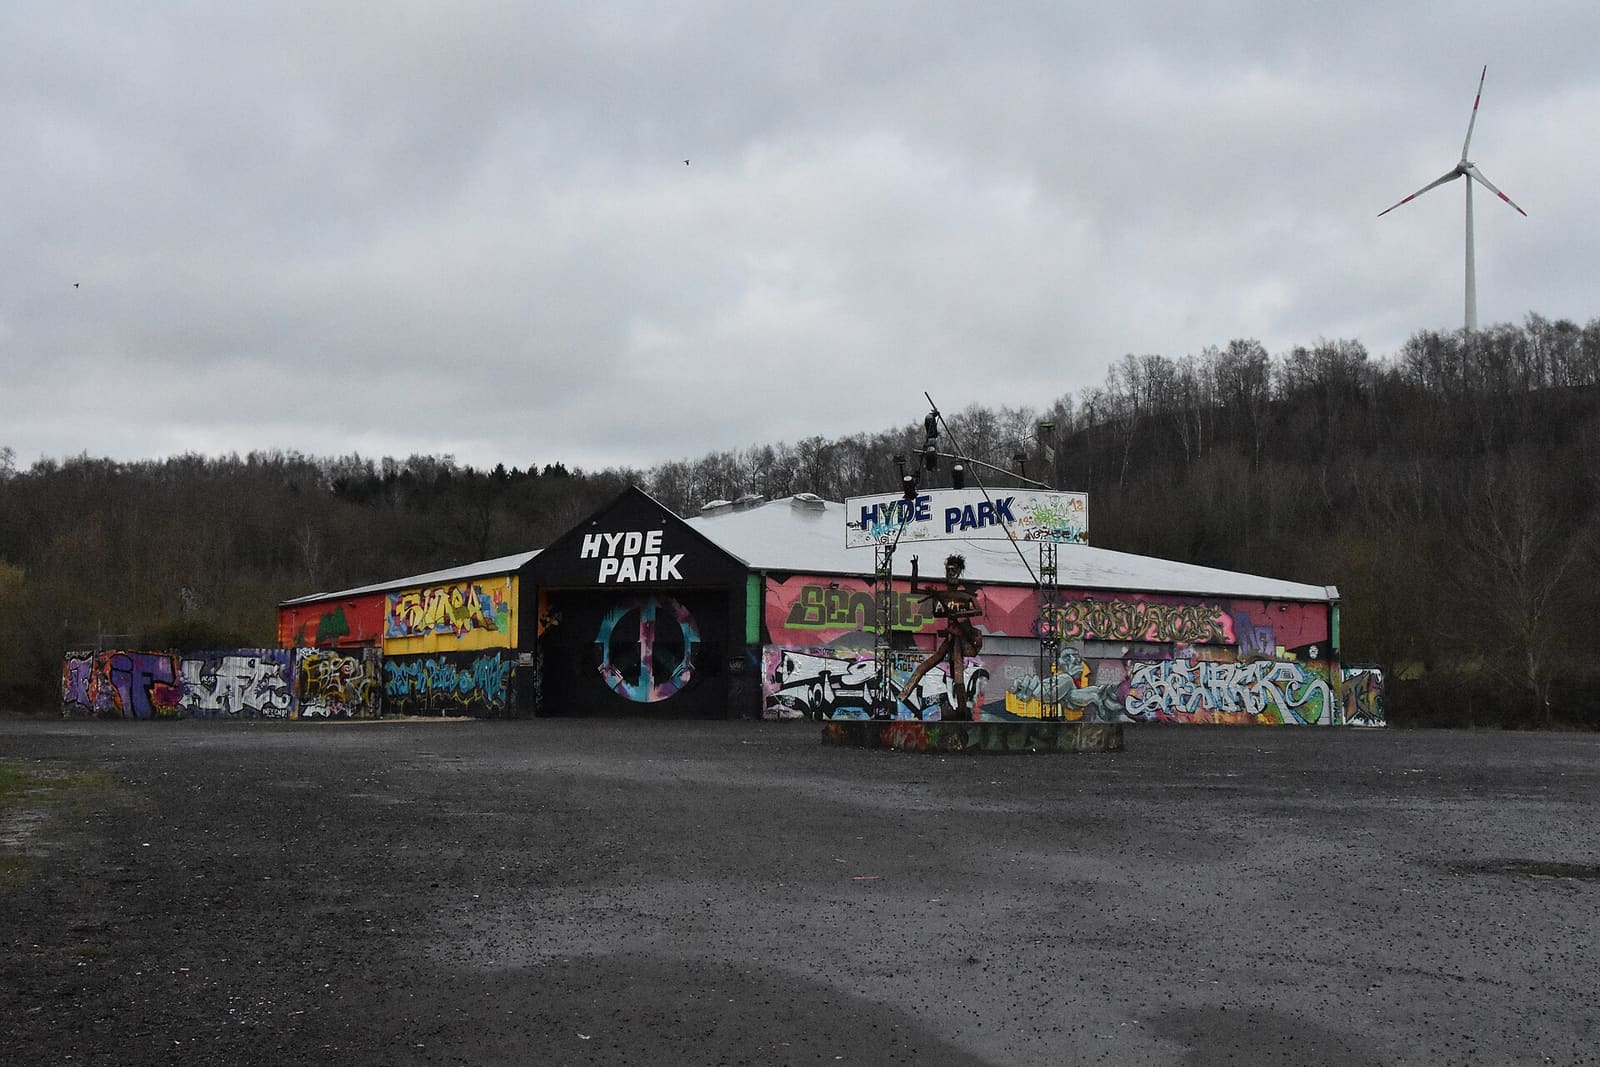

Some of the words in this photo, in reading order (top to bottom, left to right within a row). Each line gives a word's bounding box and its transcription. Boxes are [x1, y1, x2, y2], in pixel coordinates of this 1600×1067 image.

[861, 494, 933, 531] HYDE
[945, 497, 1016, 533] PARK
[580, 530, 663, 559] HYDE
[598, 554, 685, 583] PARK
